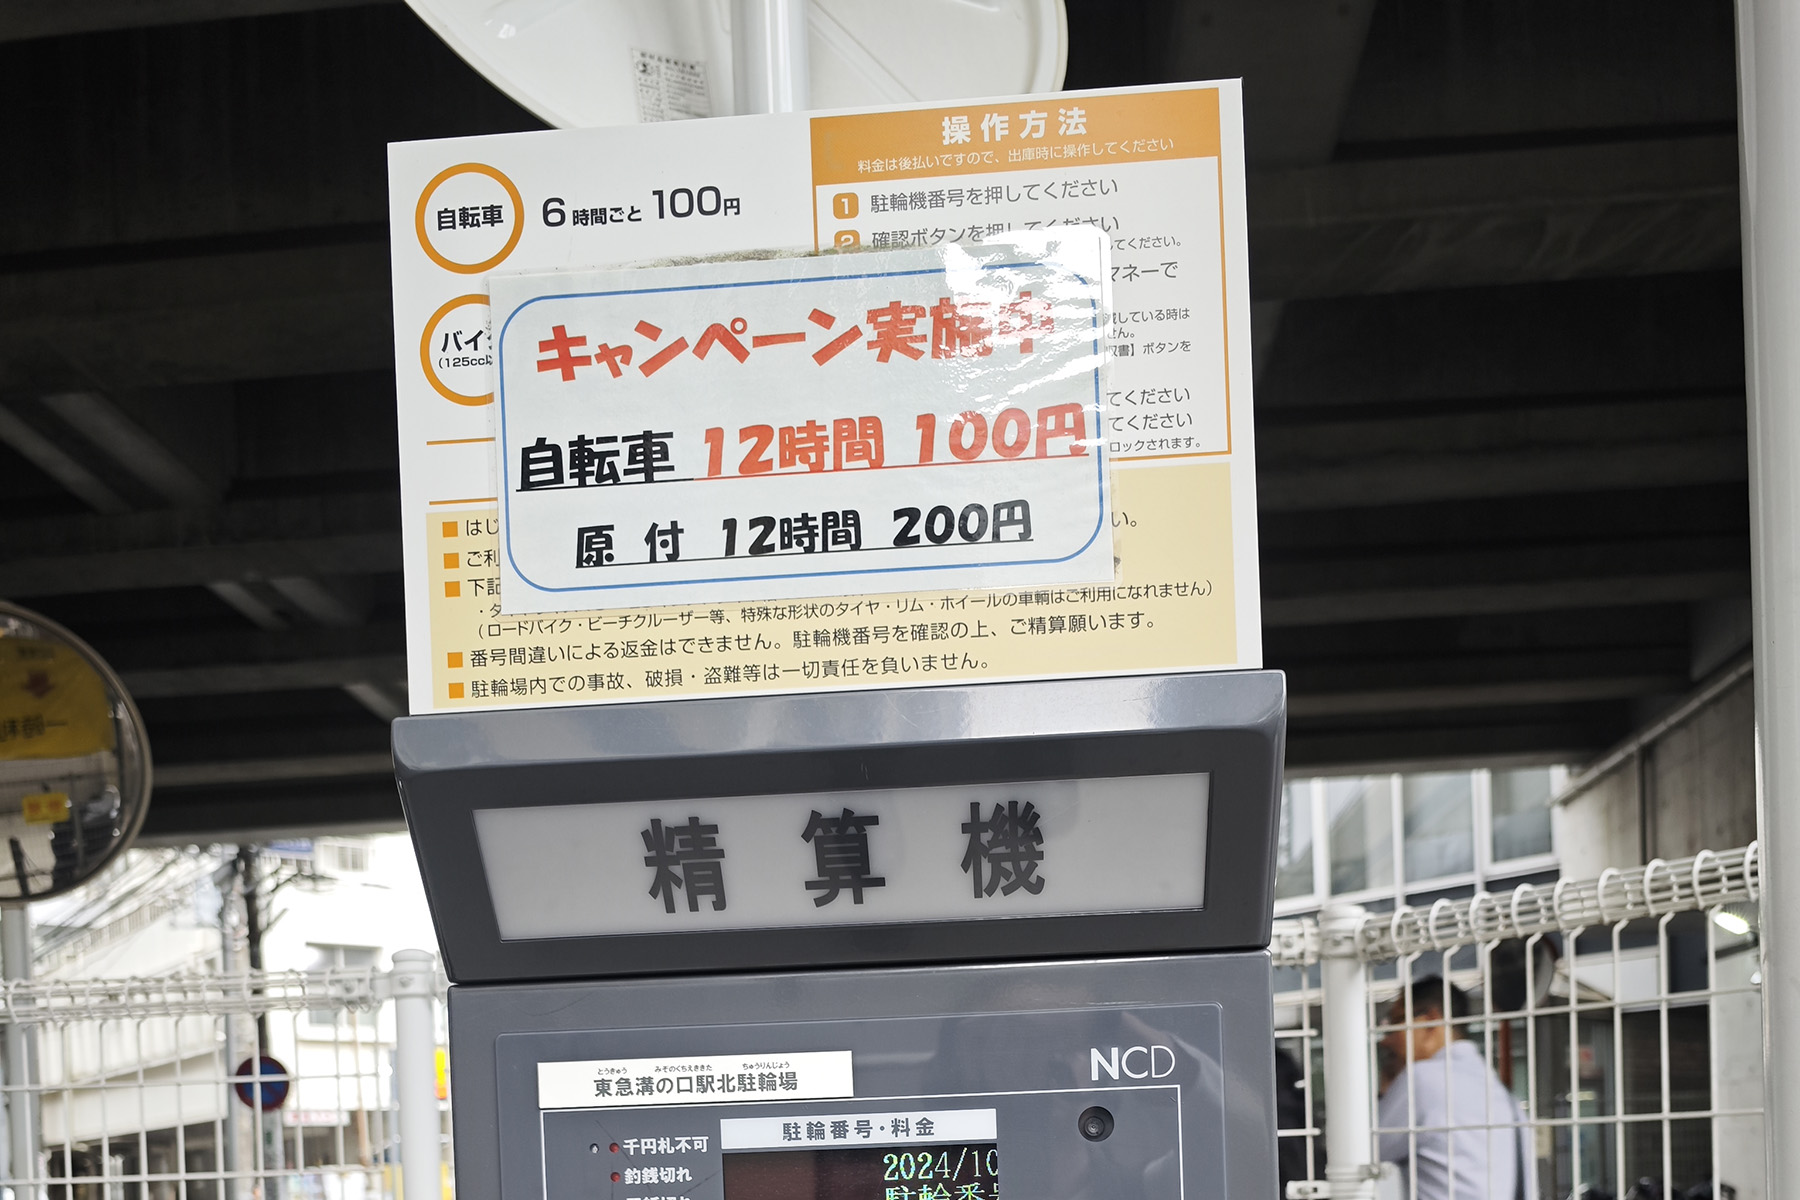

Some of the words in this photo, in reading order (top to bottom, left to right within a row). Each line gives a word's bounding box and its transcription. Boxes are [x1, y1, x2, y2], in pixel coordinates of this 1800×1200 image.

[941, 107, 1088, 145] 操作方法
[857, 137, 1174, 174] 料金は後払いですので、出庫時に操作してください
[870, 178, 1118, 213] 駐輪機番号を押してください
[437, 204, 504, 231] 自転車
[1110, 236, 1182, 250] てください。
[441, 330, 492, 352] バイ
[537, 290, 1054, 382] キャンペーン実施中
[1106, 388, 1190, 407] てください
[1109, 413, 1193, 432] てください
[520, 430, 675, 491] 自転車
[704, 416, 884, 478] 12時間
[915, 403, 1089, 465] 100円
[1109, 437, 1201, 453] ロックされます。
[722, 509, 862, 557] 12時間
[892, 499, 1032, 547] 200円
[471, 652, 988, 698] 駐輪場内での事故、破損・盗難等は一切責任を負いません。
[640, 801, 1046, 914] 精算機
[1090, 1045, 1176, 1081] NCD
[594, 1071, 798, 1097] 東急溝の口駅北駐輪場
[782, 1117, 935, 1141] 駐輪番号・料金
[623, 1136, 709, 1156] 千円札不可
[624, 1167, 692, 1185] 釣銭切れ
